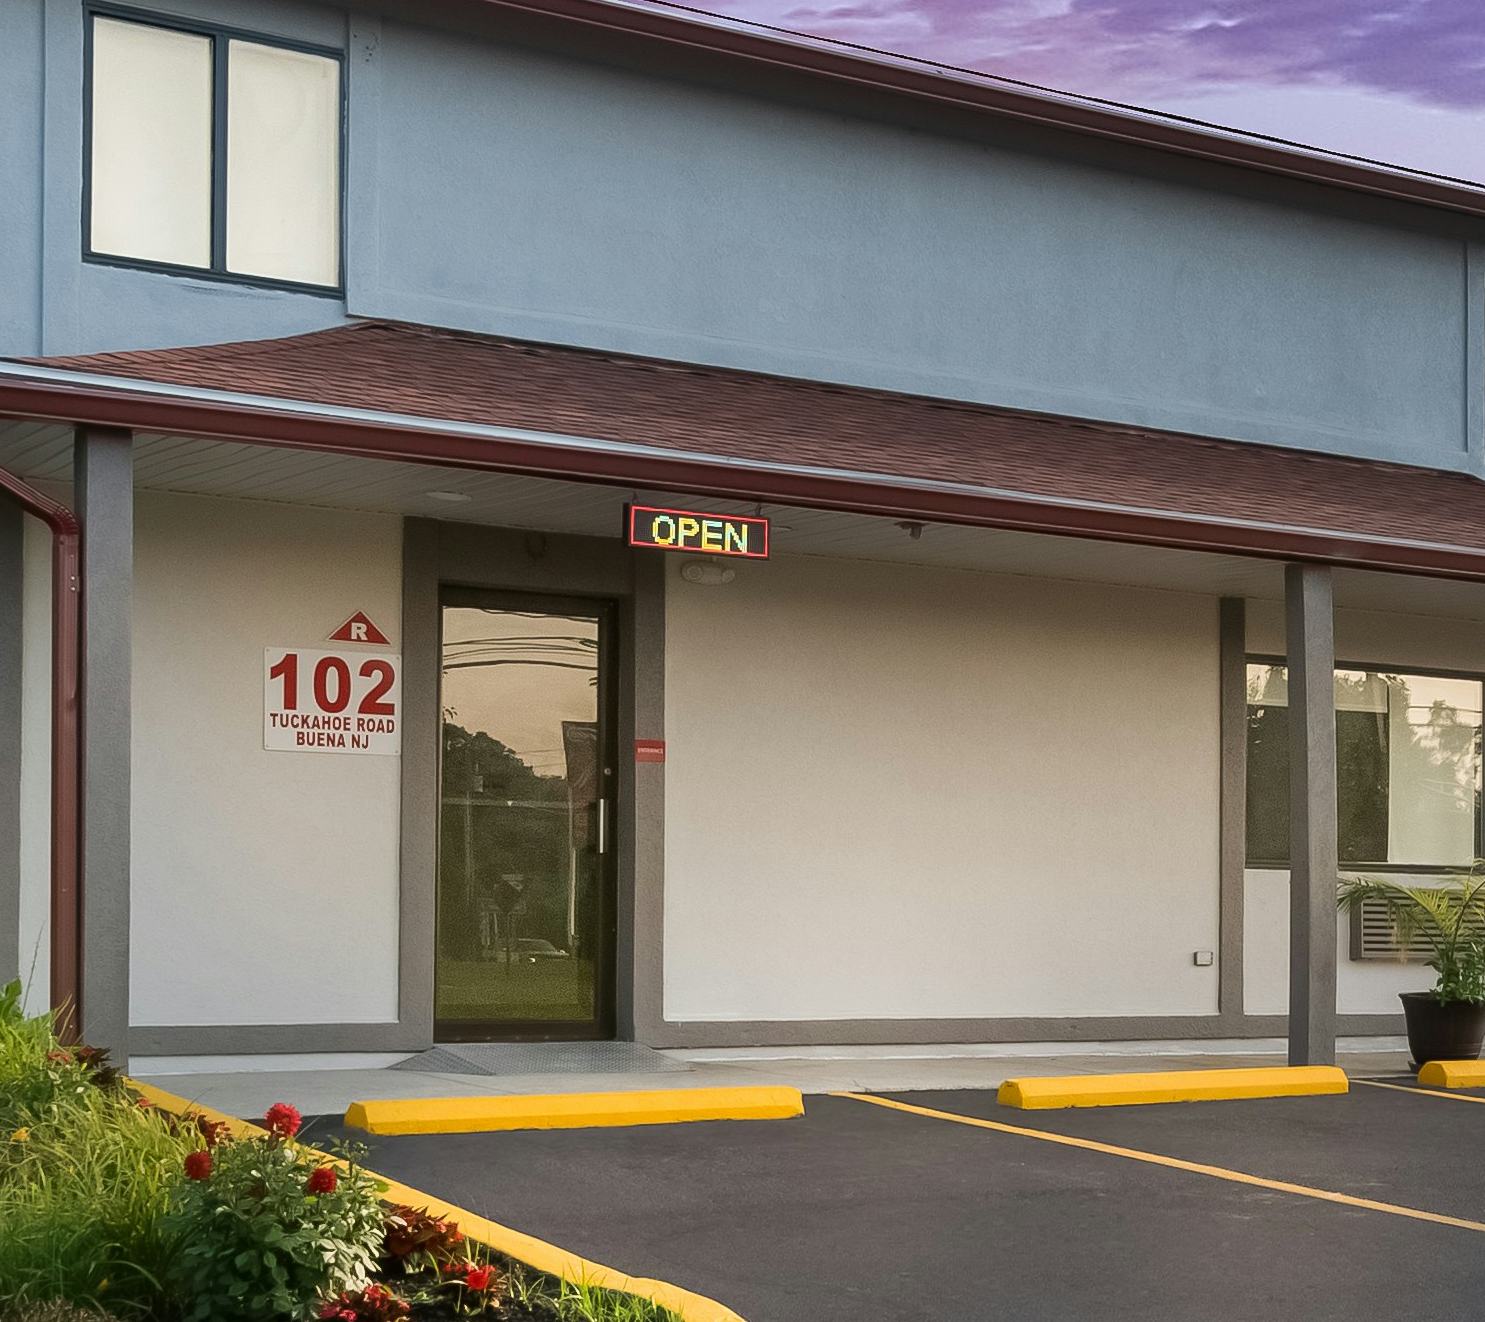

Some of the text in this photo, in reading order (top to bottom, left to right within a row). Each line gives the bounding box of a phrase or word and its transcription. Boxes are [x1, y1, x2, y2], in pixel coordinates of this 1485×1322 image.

[652, 515, 748, 553] OPEN
[351, 622, 368, 641] R
[270, 653, 395, 716] 102
[270, 713, 395, 734] TUCKAHOE ROAD
[296, 731, 369, 749] BUENA NJ
